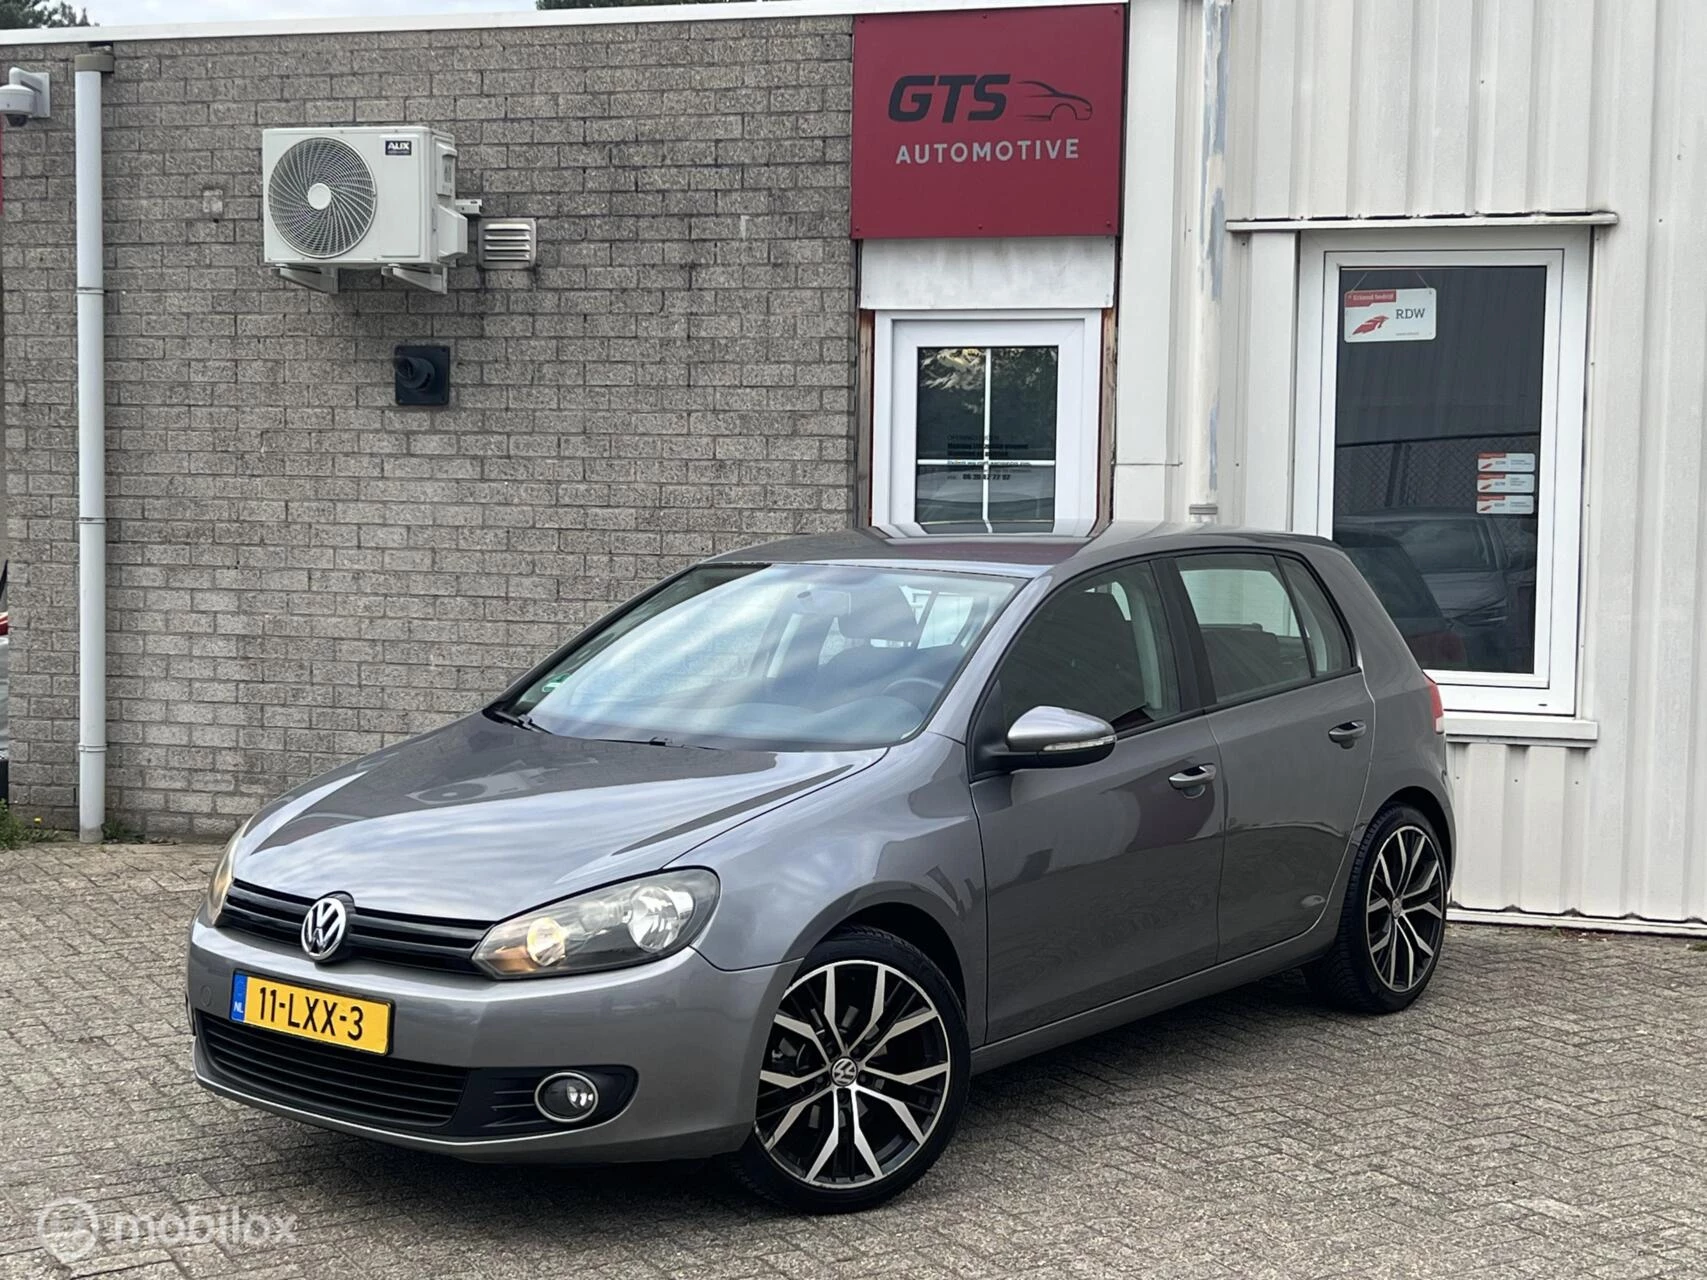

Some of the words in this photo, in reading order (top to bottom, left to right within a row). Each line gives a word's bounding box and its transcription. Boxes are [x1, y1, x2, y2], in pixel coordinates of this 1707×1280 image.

[888, 74, 1011, 123] GTS
[895, 138, 1079, 165] AUTOMOTIVE
[1395, 307, 1425, 320] RDW
[233, 1000, 244, 1014] NL
[259, 986, 364, 1041] 11-LXX-3
